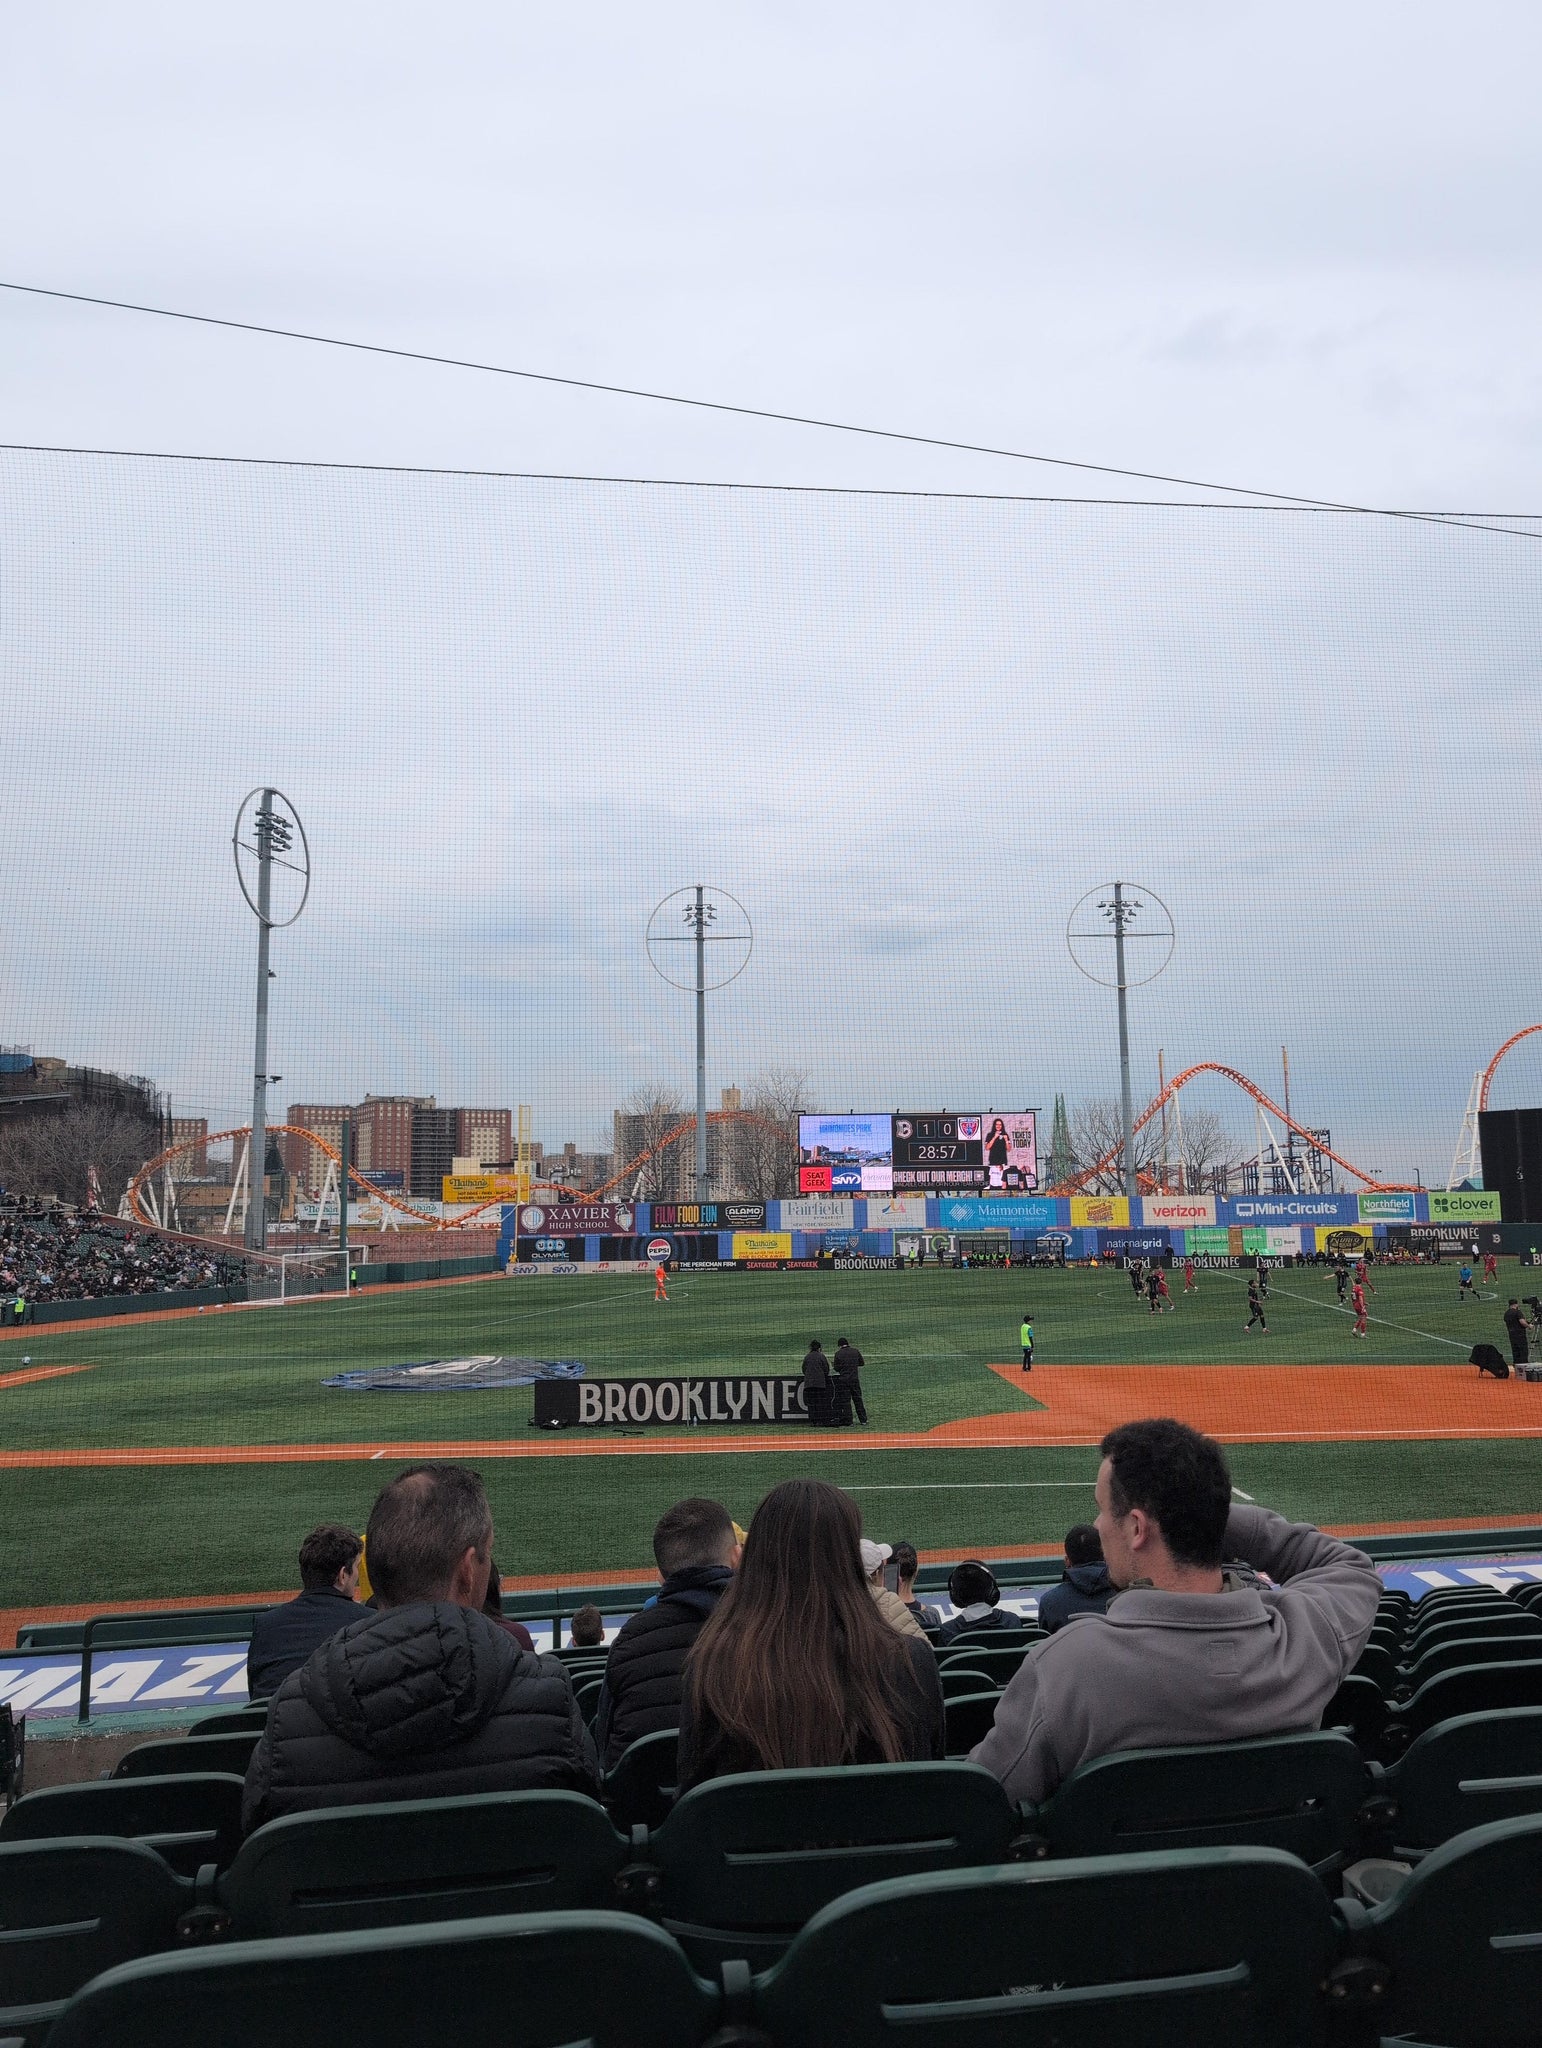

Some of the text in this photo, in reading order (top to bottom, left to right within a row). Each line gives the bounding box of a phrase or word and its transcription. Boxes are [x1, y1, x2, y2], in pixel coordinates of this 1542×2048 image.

[923, 1124, 951, 1135] 1 0
[1012, 1139, 1032, 1148] TODAY
[918, 1146, 957, 1159] 28:57
[832, 1176, 857, 1184] SNY
[893, 1171, 916, 1182] CHECK
[917, 1171, 931, 1182] OUT
[931, 1170, 946, 1182] OUR
[946, 1170, 973, 1182] MERCH!
[449, 1178, 488, 1187] Nathan's
[806, 1179, 826, 1187] GEEK
[788, 1200, 844, 1215] Fairfield
[1255, 1202, 1338, 1215] Mini-Circuits
[1363, 1199, 1410, 1209] Northfield
[1450, 1197, 1494, 1210] clover
[549, 1207, 611, 1220] XAVIER
[655, 1205, 717, 1224] FILM FOOD FUN
[978, 1203, 1048, 1216] Maimonides
[1152, 1204, 1207, 1217] verizon
[573, 1221, 610, 1229] SCHOOL
[1410, 1228, 1479, 1241] BROOKLYN FC
[922, 1235, 957, 1254] TGI
[531, 1251, 570, 1259] OLYMPIC
[746, 1261, 778, 1269] SEATGEEK
[834, 1259, 898, 1270] BROOKLYN FC
[1230, 1257, 1240, 1266] FC
[513, 1265, 535, 1274] SNY
[552, 1265, 574, 1273] SNY
[578, 1380, 775, 1424] BROOKLYN
